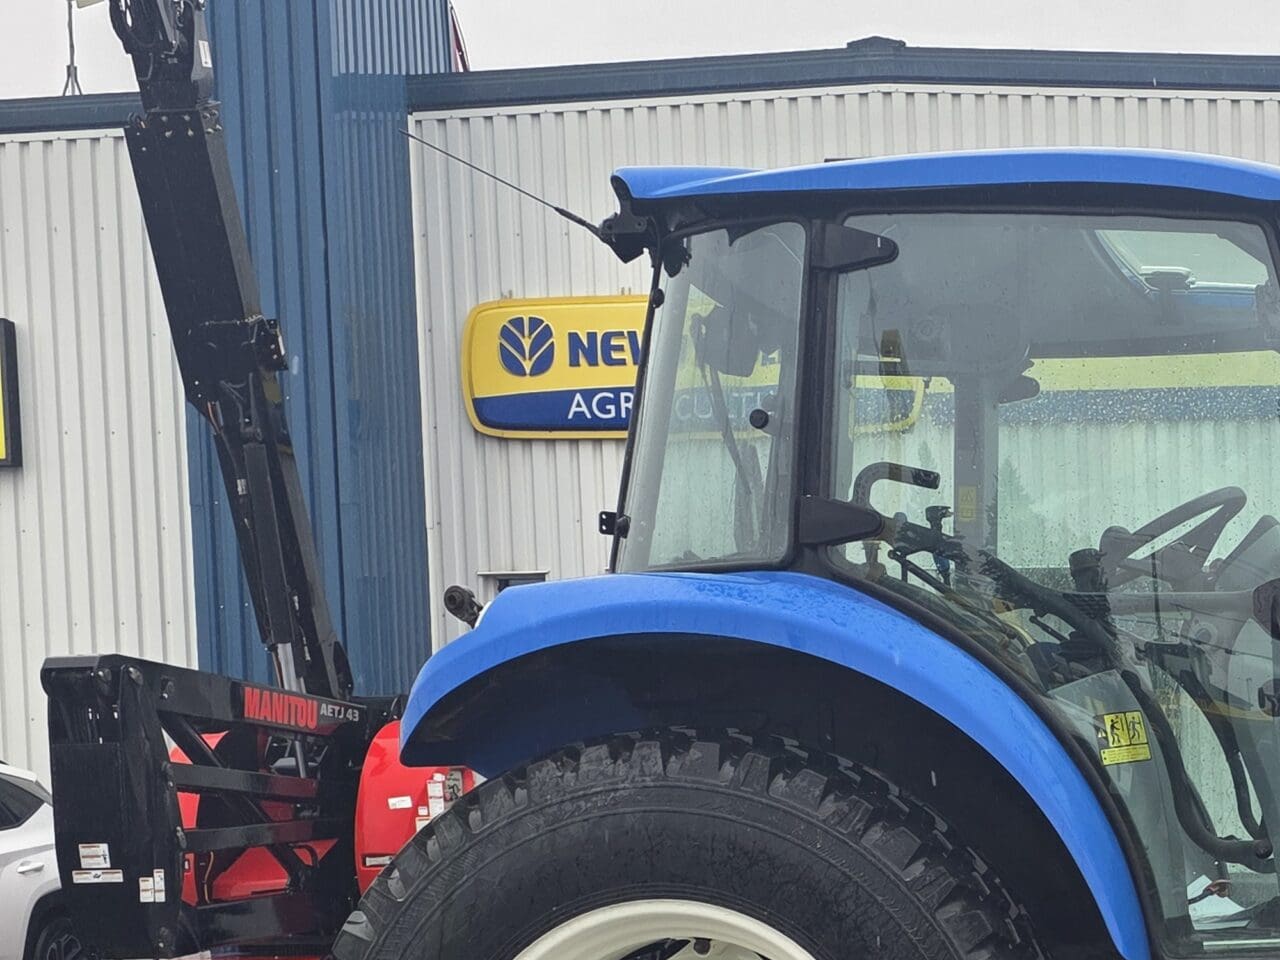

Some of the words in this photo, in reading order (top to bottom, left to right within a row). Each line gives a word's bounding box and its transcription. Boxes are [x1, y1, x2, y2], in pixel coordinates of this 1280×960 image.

[244, 686, 319, 730] MANITOU
[320, 703, 345, 719] AETJ
[346, 708, 360, 722] 43
